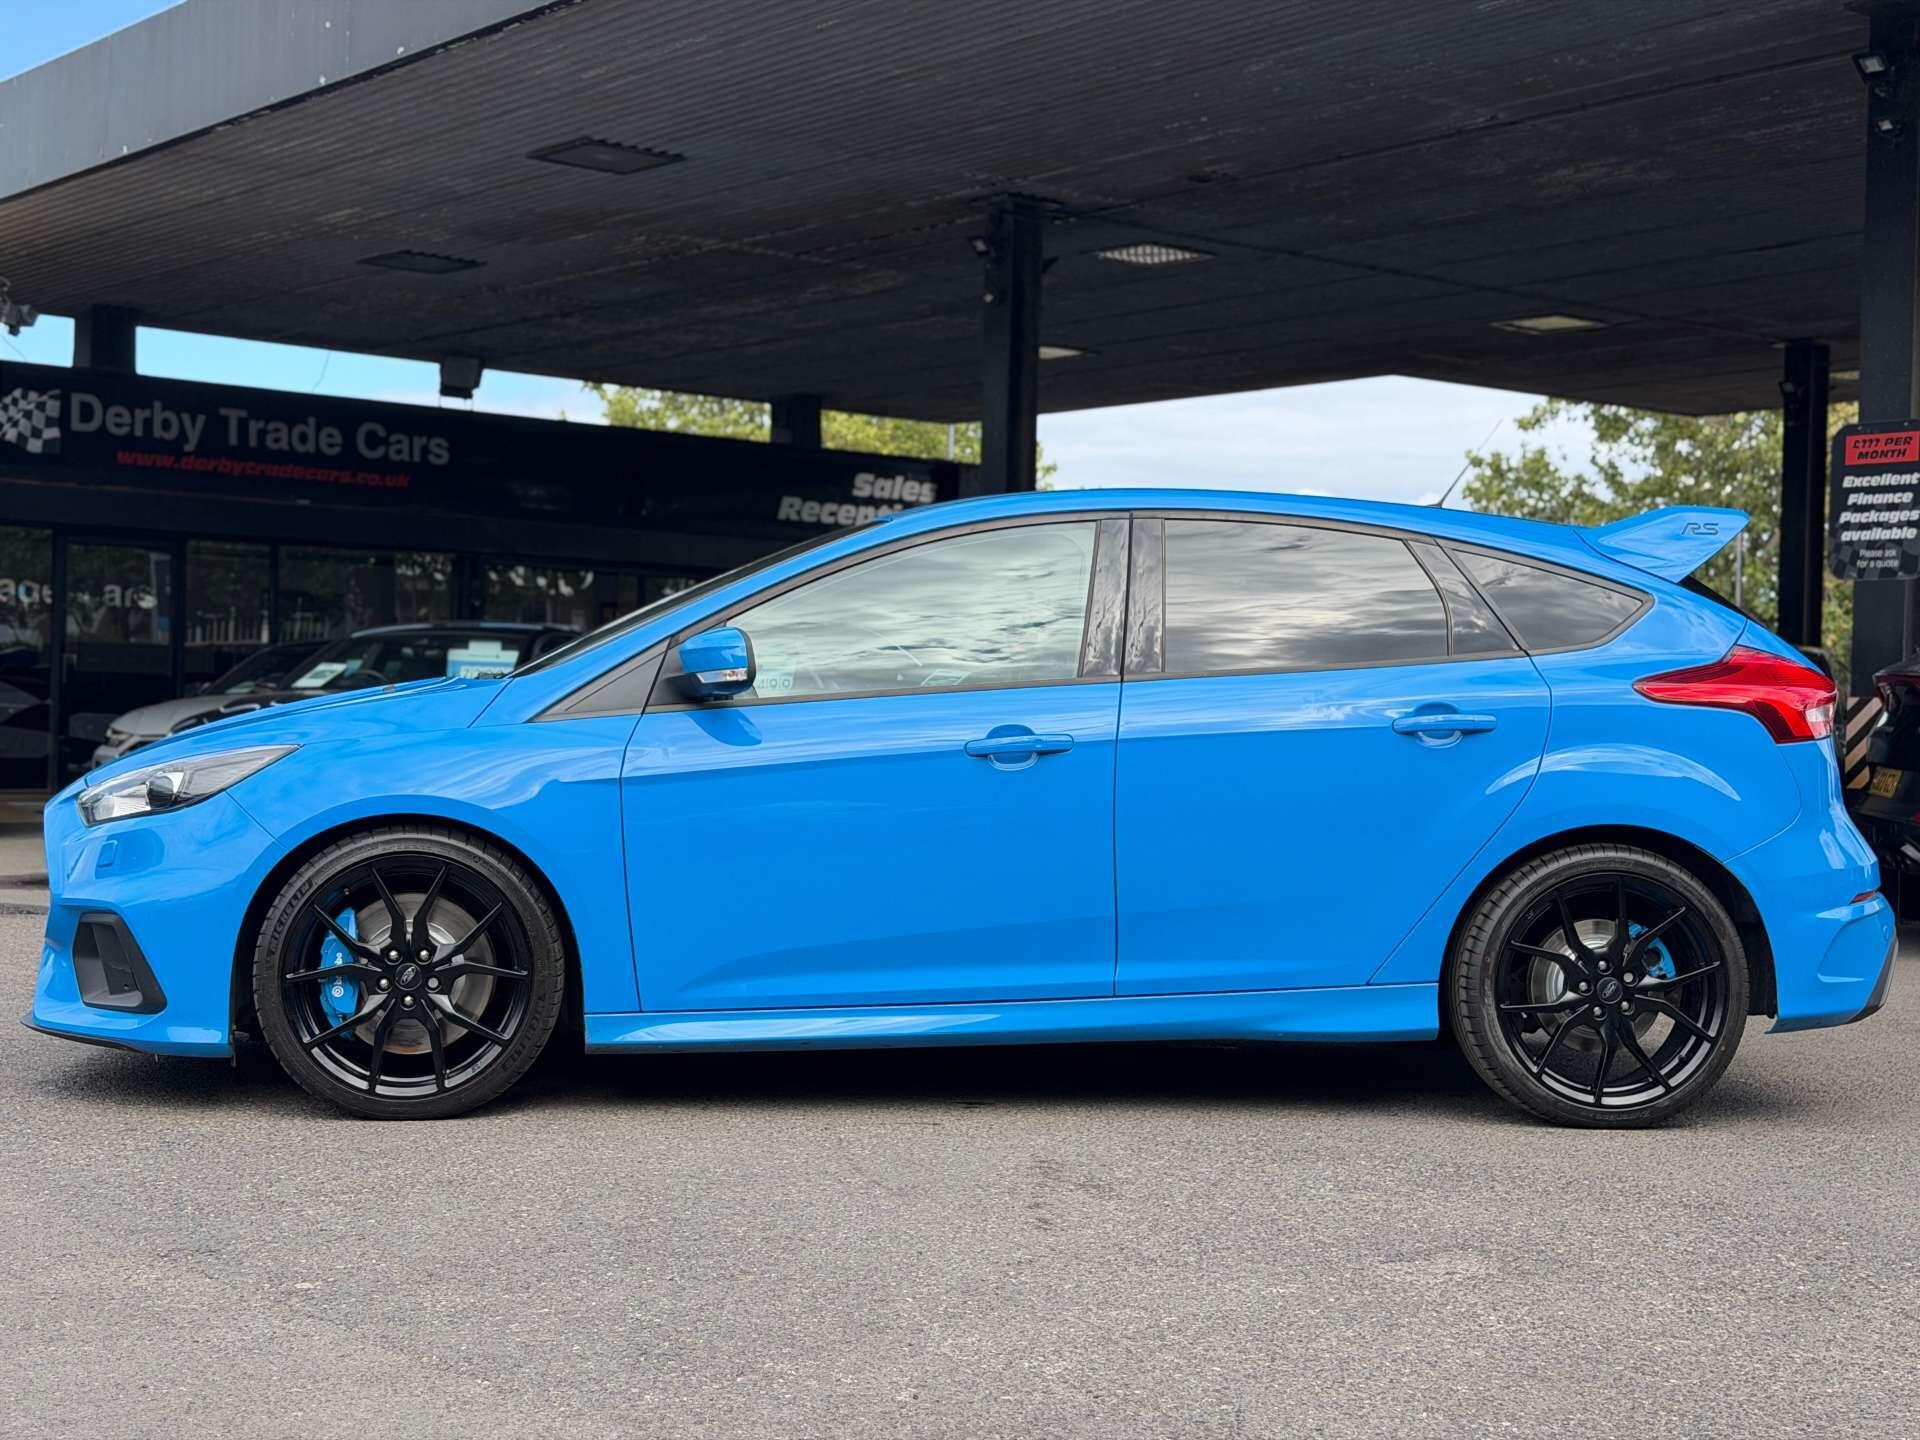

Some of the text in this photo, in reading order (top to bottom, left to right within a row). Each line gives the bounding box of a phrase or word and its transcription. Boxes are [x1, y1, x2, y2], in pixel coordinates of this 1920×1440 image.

[69, 393, 451, 466] Derby Trade Cars
[1884, 436, 1913, 446] PER
[1857, 448, 1908, 460] MONTH
[116, 450, 411, 488] www.derbytradecars.co.uk
[1842, 471, 1920, 488] Excellent
[851, 472, 938, 504] Sales
[1847, 491, 1914, 506] Finance
[1839, 509, 1920, 524] Packages
[1681, 522, 1719, 535] RS
[1841, 527, 1918, 541] available
